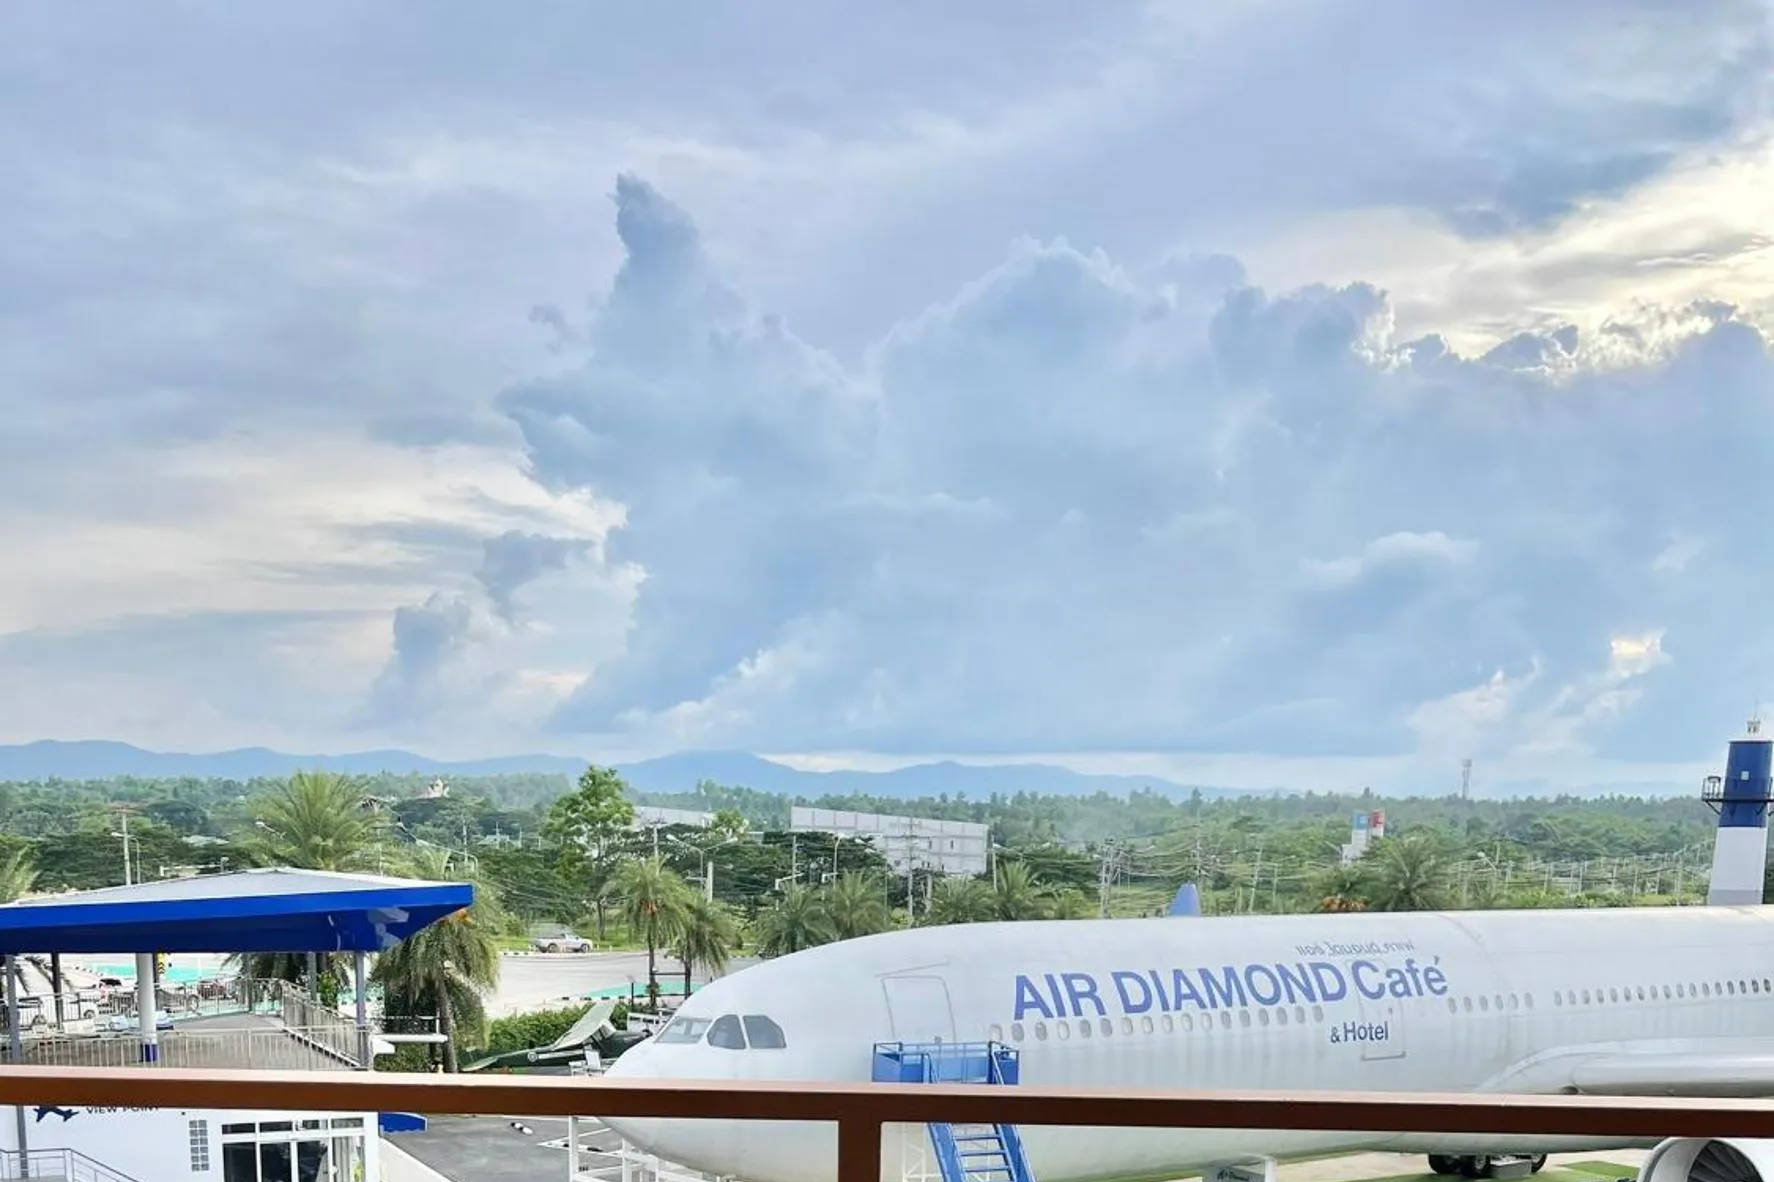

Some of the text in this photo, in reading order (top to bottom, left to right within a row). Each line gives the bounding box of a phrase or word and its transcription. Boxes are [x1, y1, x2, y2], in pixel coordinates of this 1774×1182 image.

[1013, 956, 1448, 1021] AIR DIAMOND Café
[1330, 1020, 1389, 1043] & Hotel
